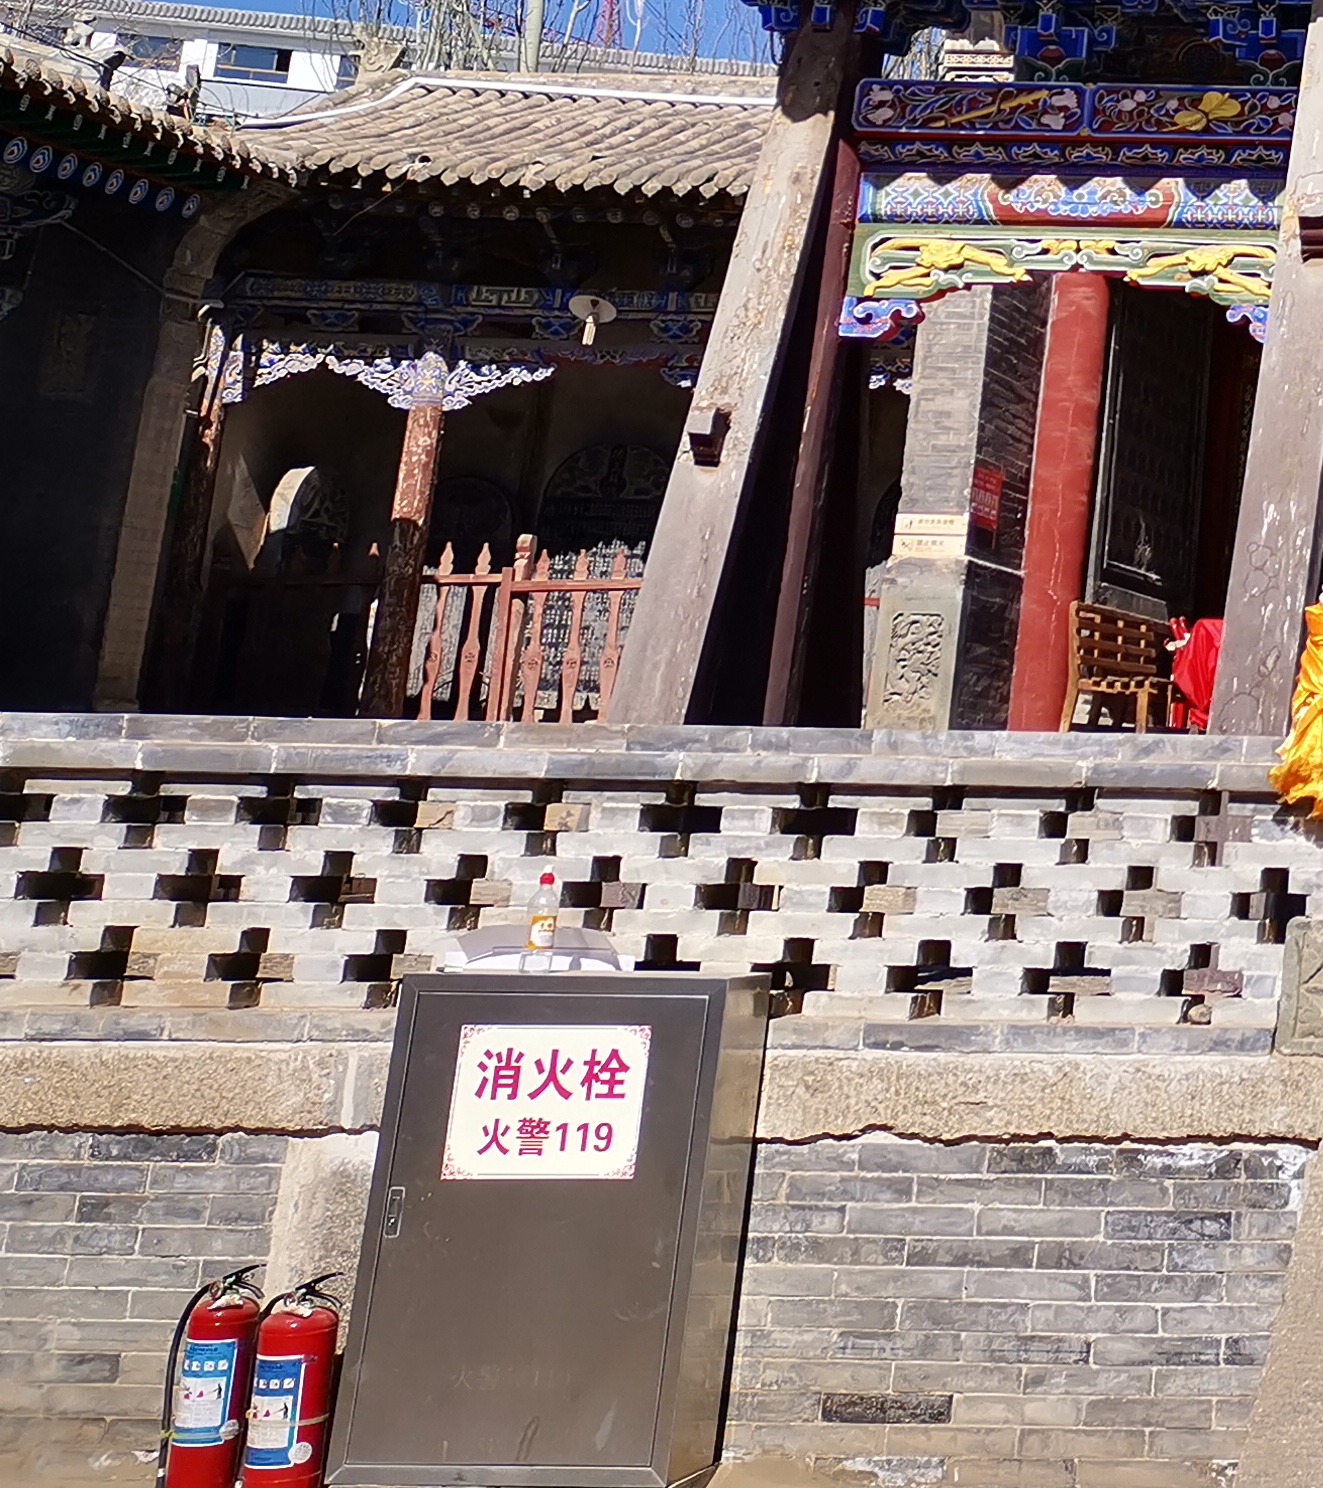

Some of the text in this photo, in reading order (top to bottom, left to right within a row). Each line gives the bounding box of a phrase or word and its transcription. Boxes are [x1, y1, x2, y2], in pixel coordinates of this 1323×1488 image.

[473, 1047, 631, 1101] 消火栓
[476, 1117, 614, 1157] 火警119
